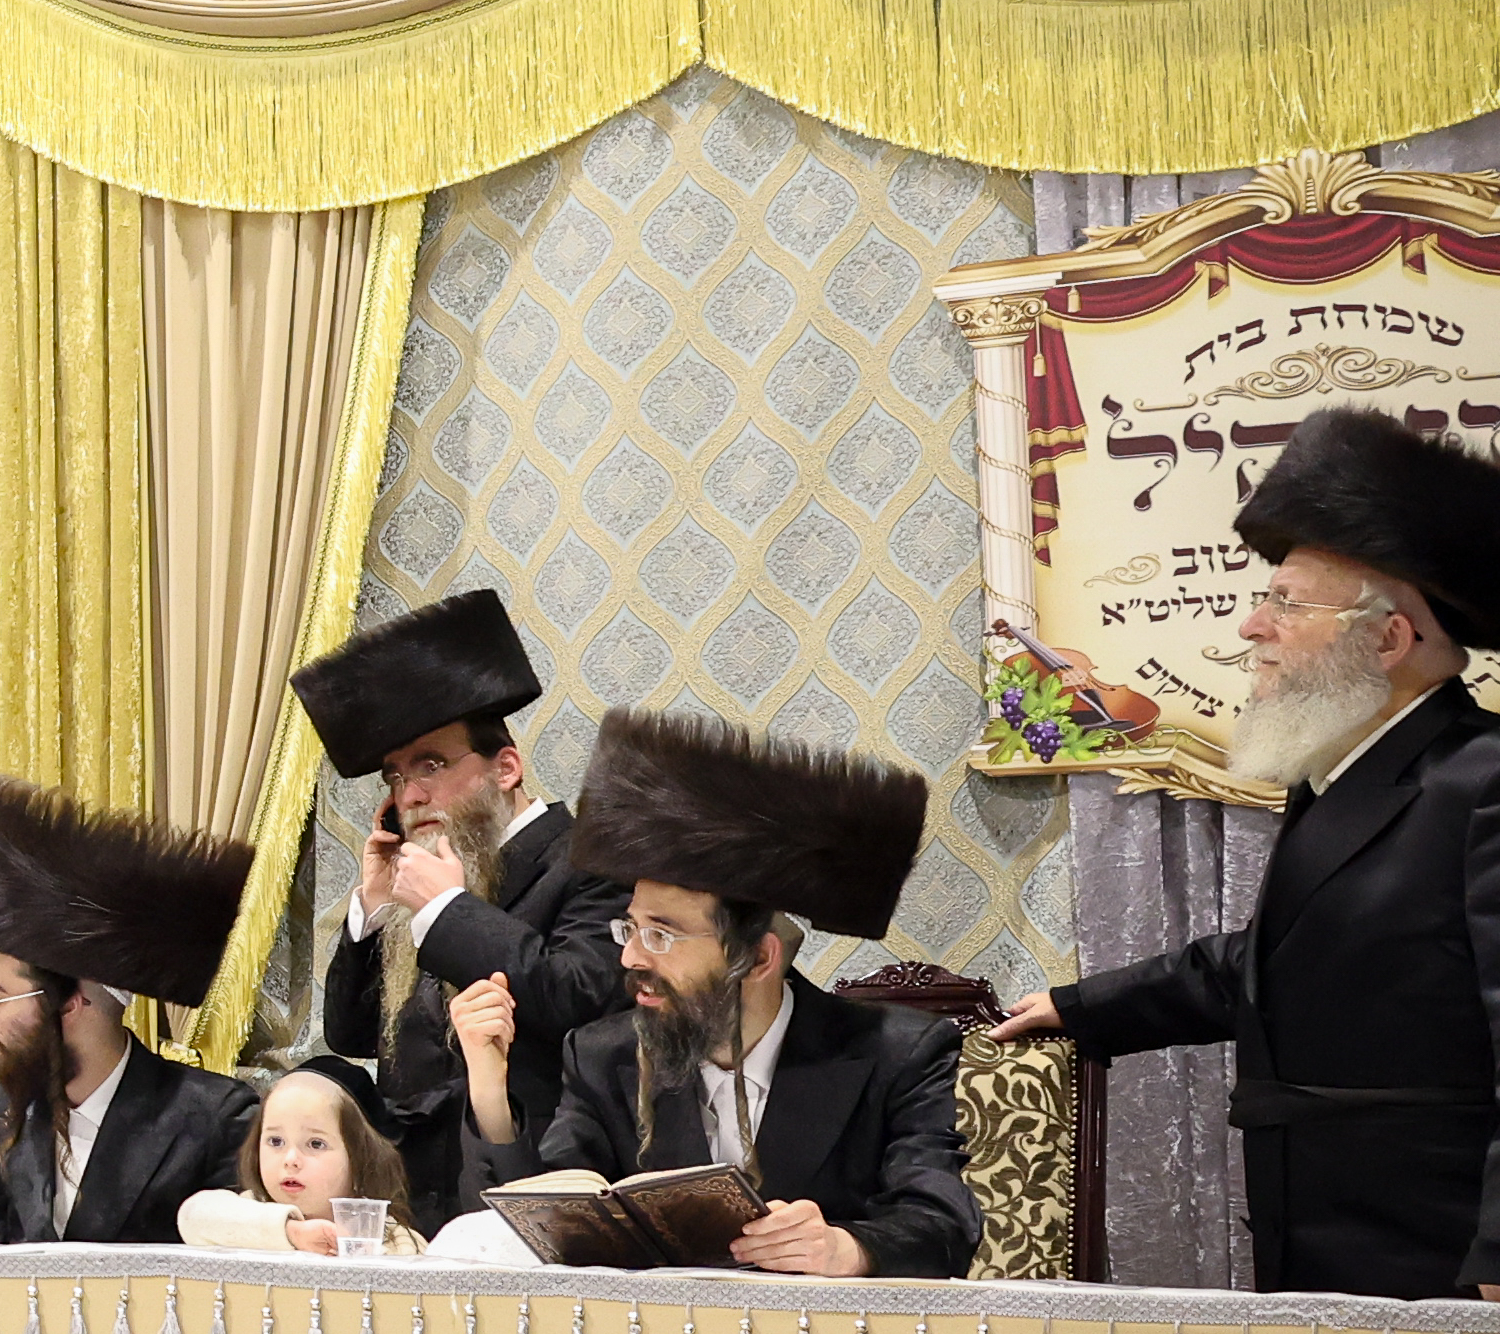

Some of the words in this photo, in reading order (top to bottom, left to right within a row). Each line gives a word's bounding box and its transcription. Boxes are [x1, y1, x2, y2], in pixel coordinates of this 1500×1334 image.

[1287, 302, 1465, 347] שמחת
[1183, 318, 1268, 385] בית
[1171, 542, 1251, 577] טוב
[1134, 657, 1225, 719] צדיקים
